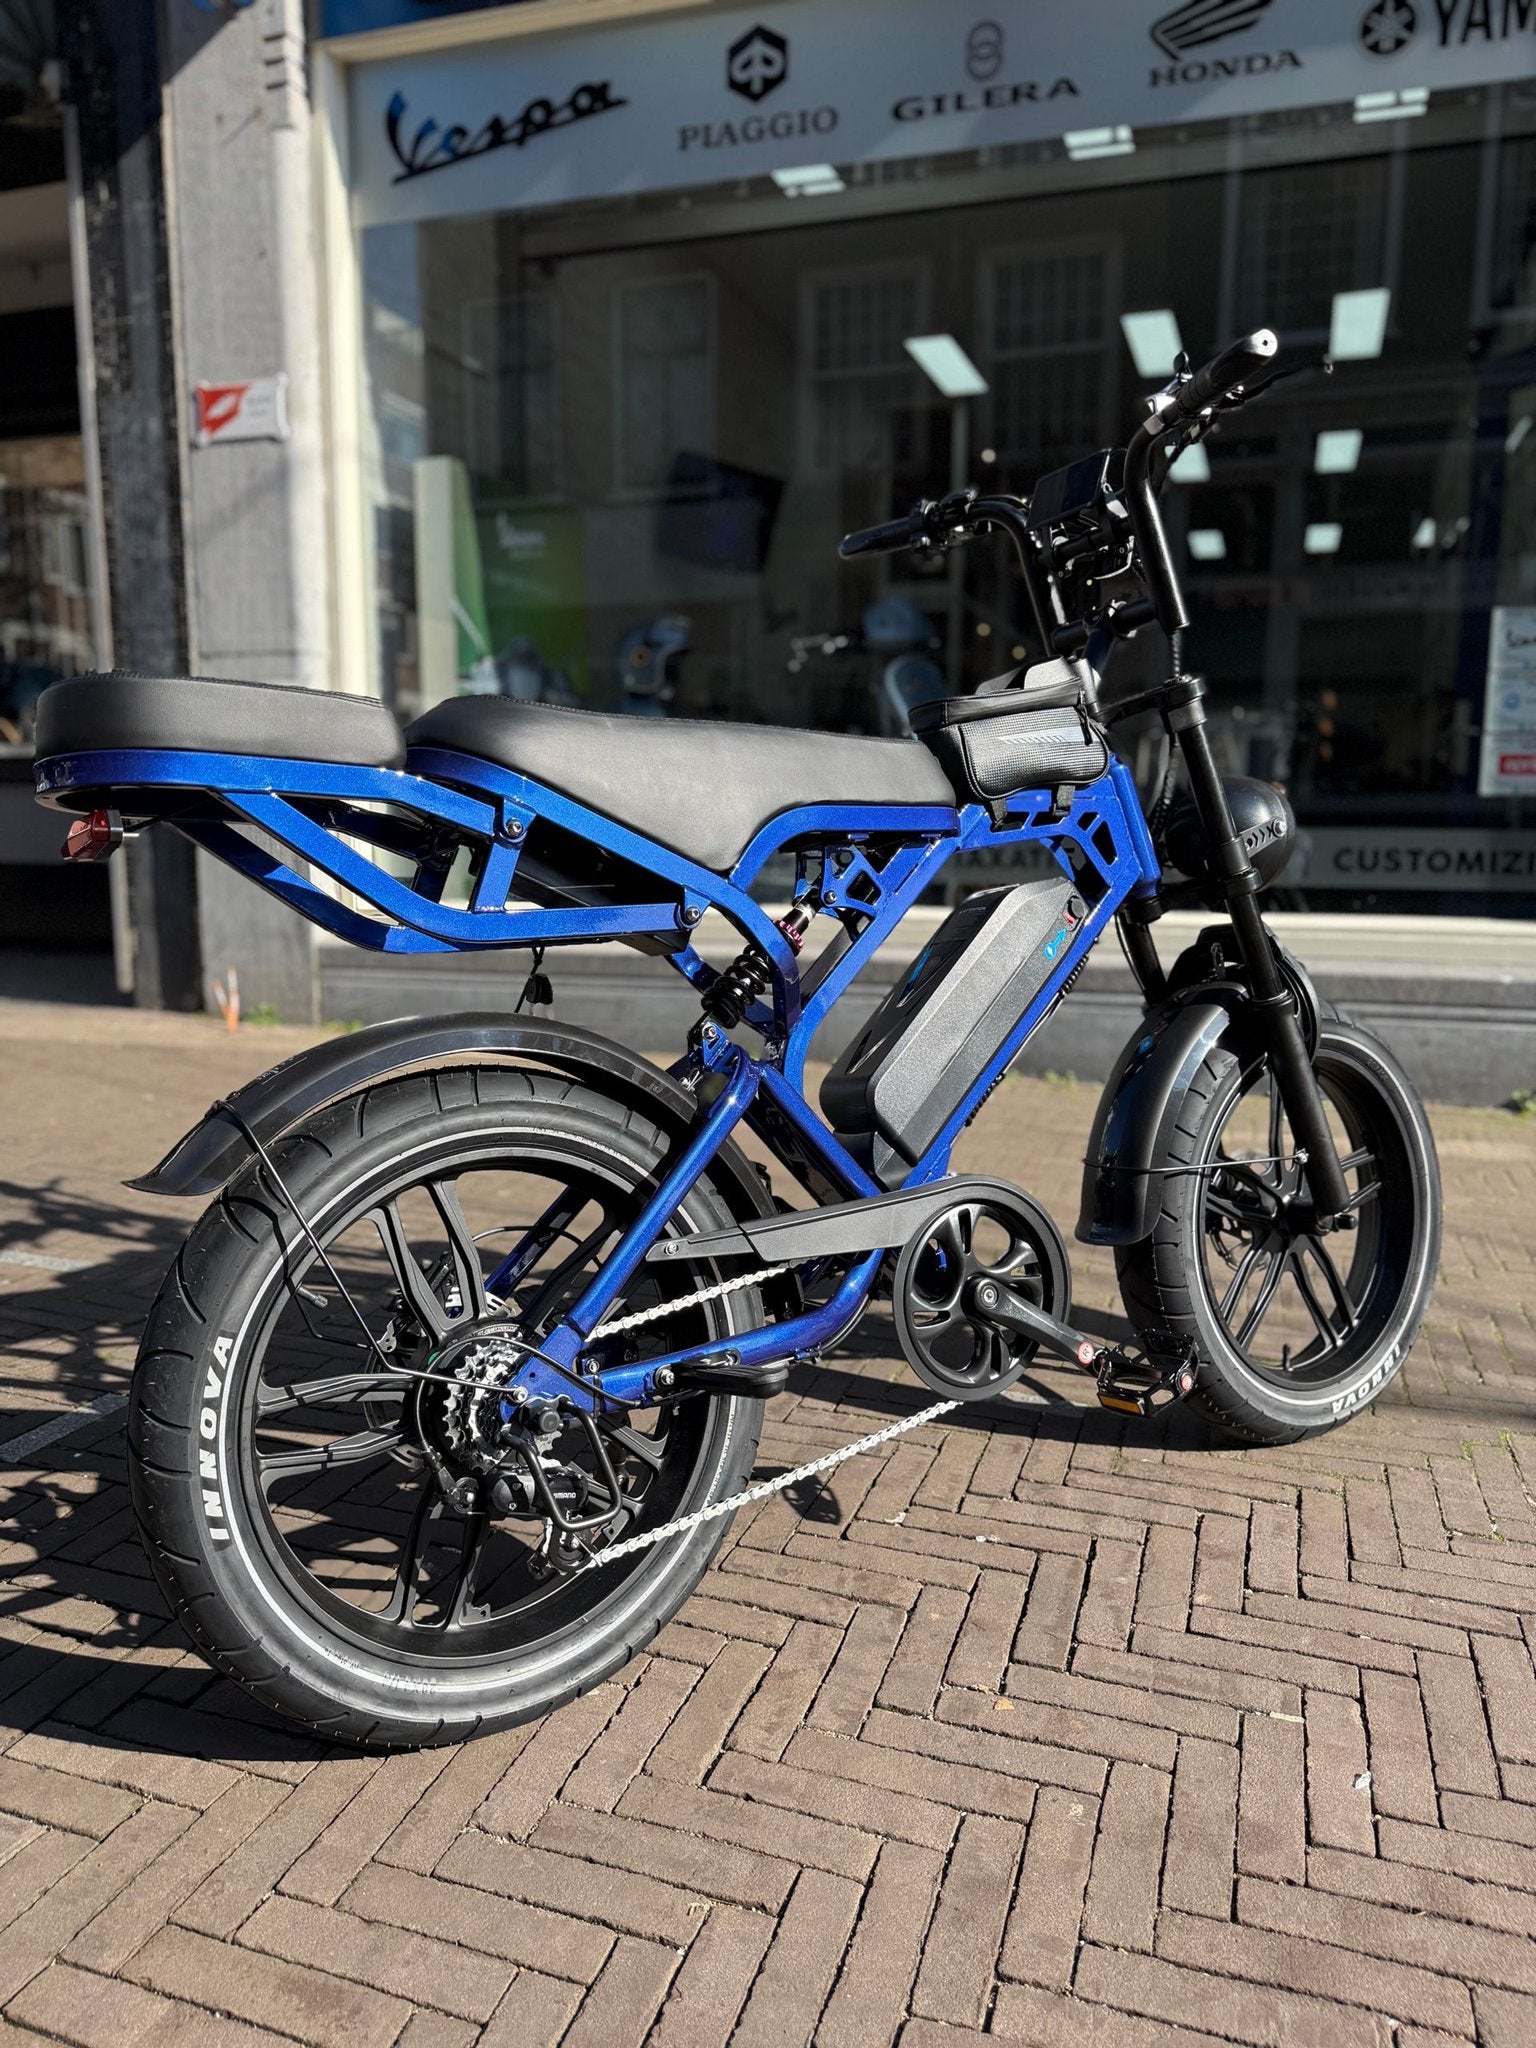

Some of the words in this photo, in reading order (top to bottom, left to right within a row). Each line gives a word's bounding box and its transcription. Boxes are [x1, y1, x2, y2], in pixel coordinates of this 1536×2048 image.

[1148, 49, 1304, 87] HONDA
[678, 105, 840, 152] PIAGGIO
[892, 77, 1081, 122] GILERA
[386, 81, 628, 184] Vespa
[1331, 1342, 1402, 1415] INNOVA
[199, 1335, 235, 1541] INNOVA
